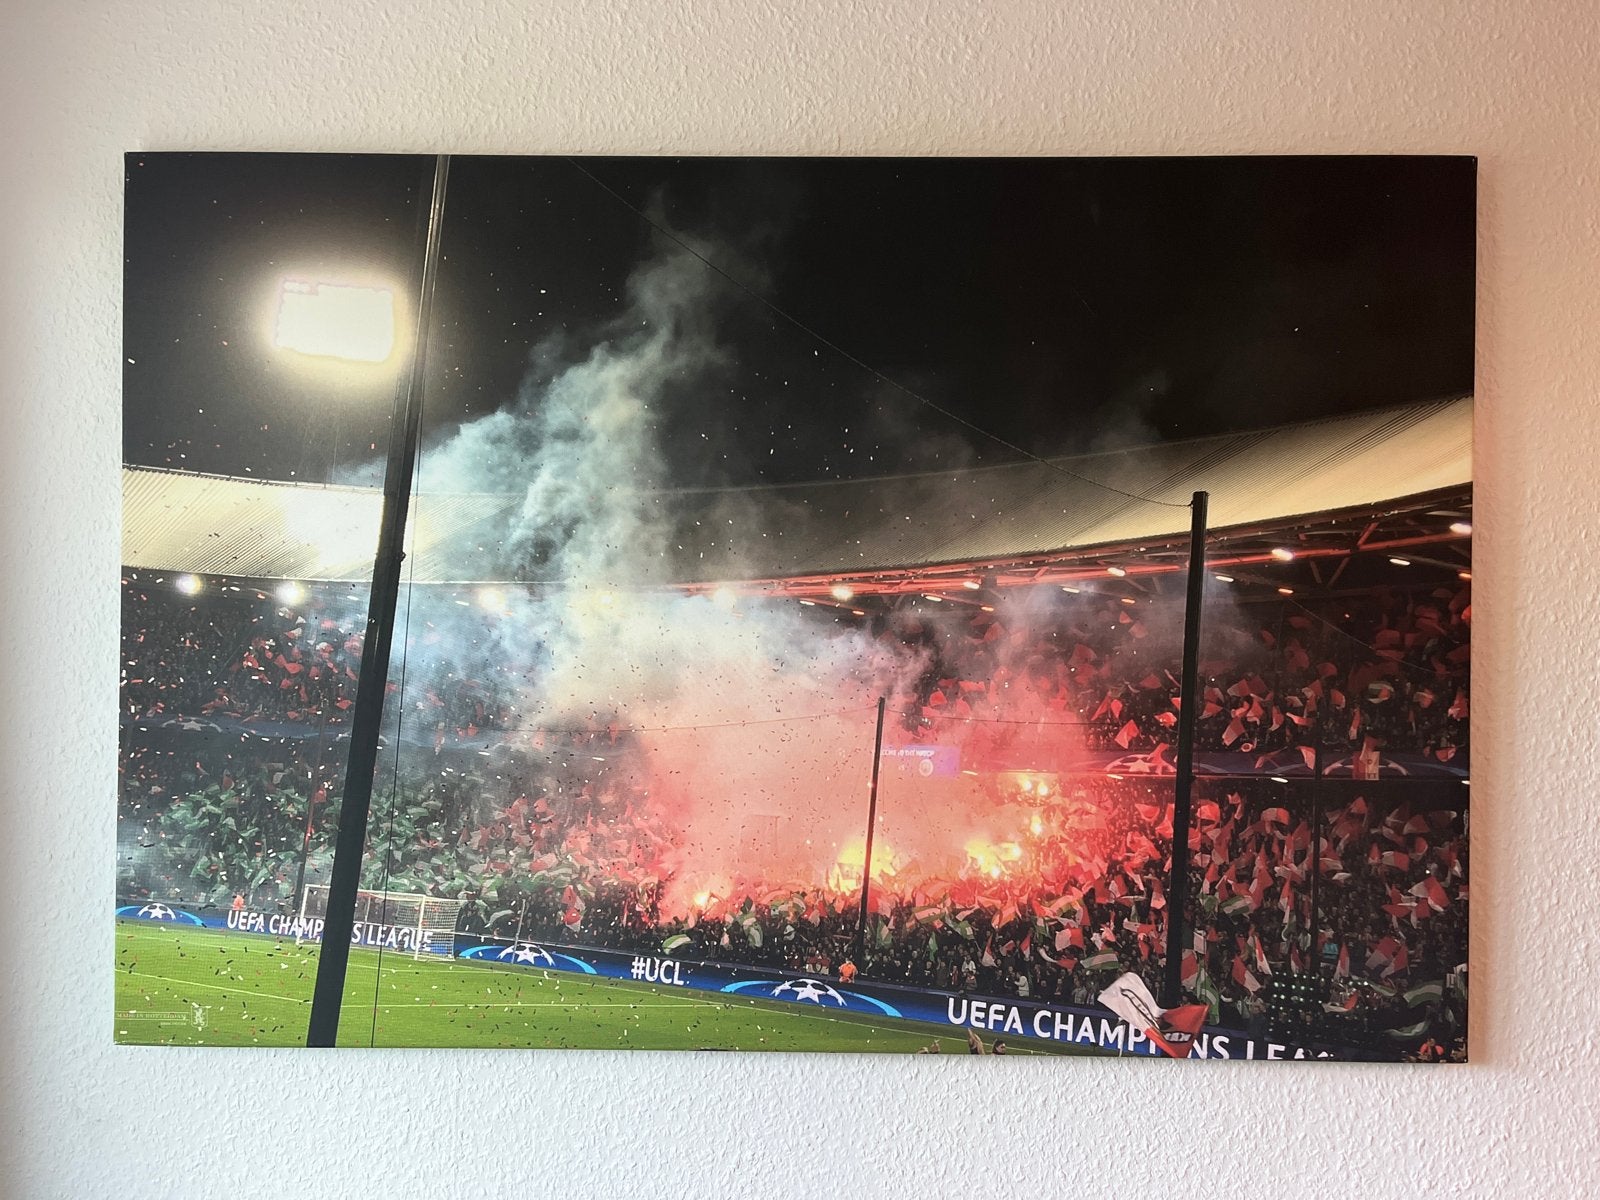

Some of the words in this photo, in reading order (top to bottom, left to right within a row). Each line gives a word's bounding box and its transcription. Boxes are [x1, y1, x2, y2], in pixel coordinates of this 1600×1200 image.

[227, 910, 264, 932] UEFA
[367, 925, 434, 951] LEAGUE
[631, 956, 685, 986] #UCL
[947, 997, 1024, 1034] UEFA
[1033, 1010, 1230, 1060] CHAMPINS
